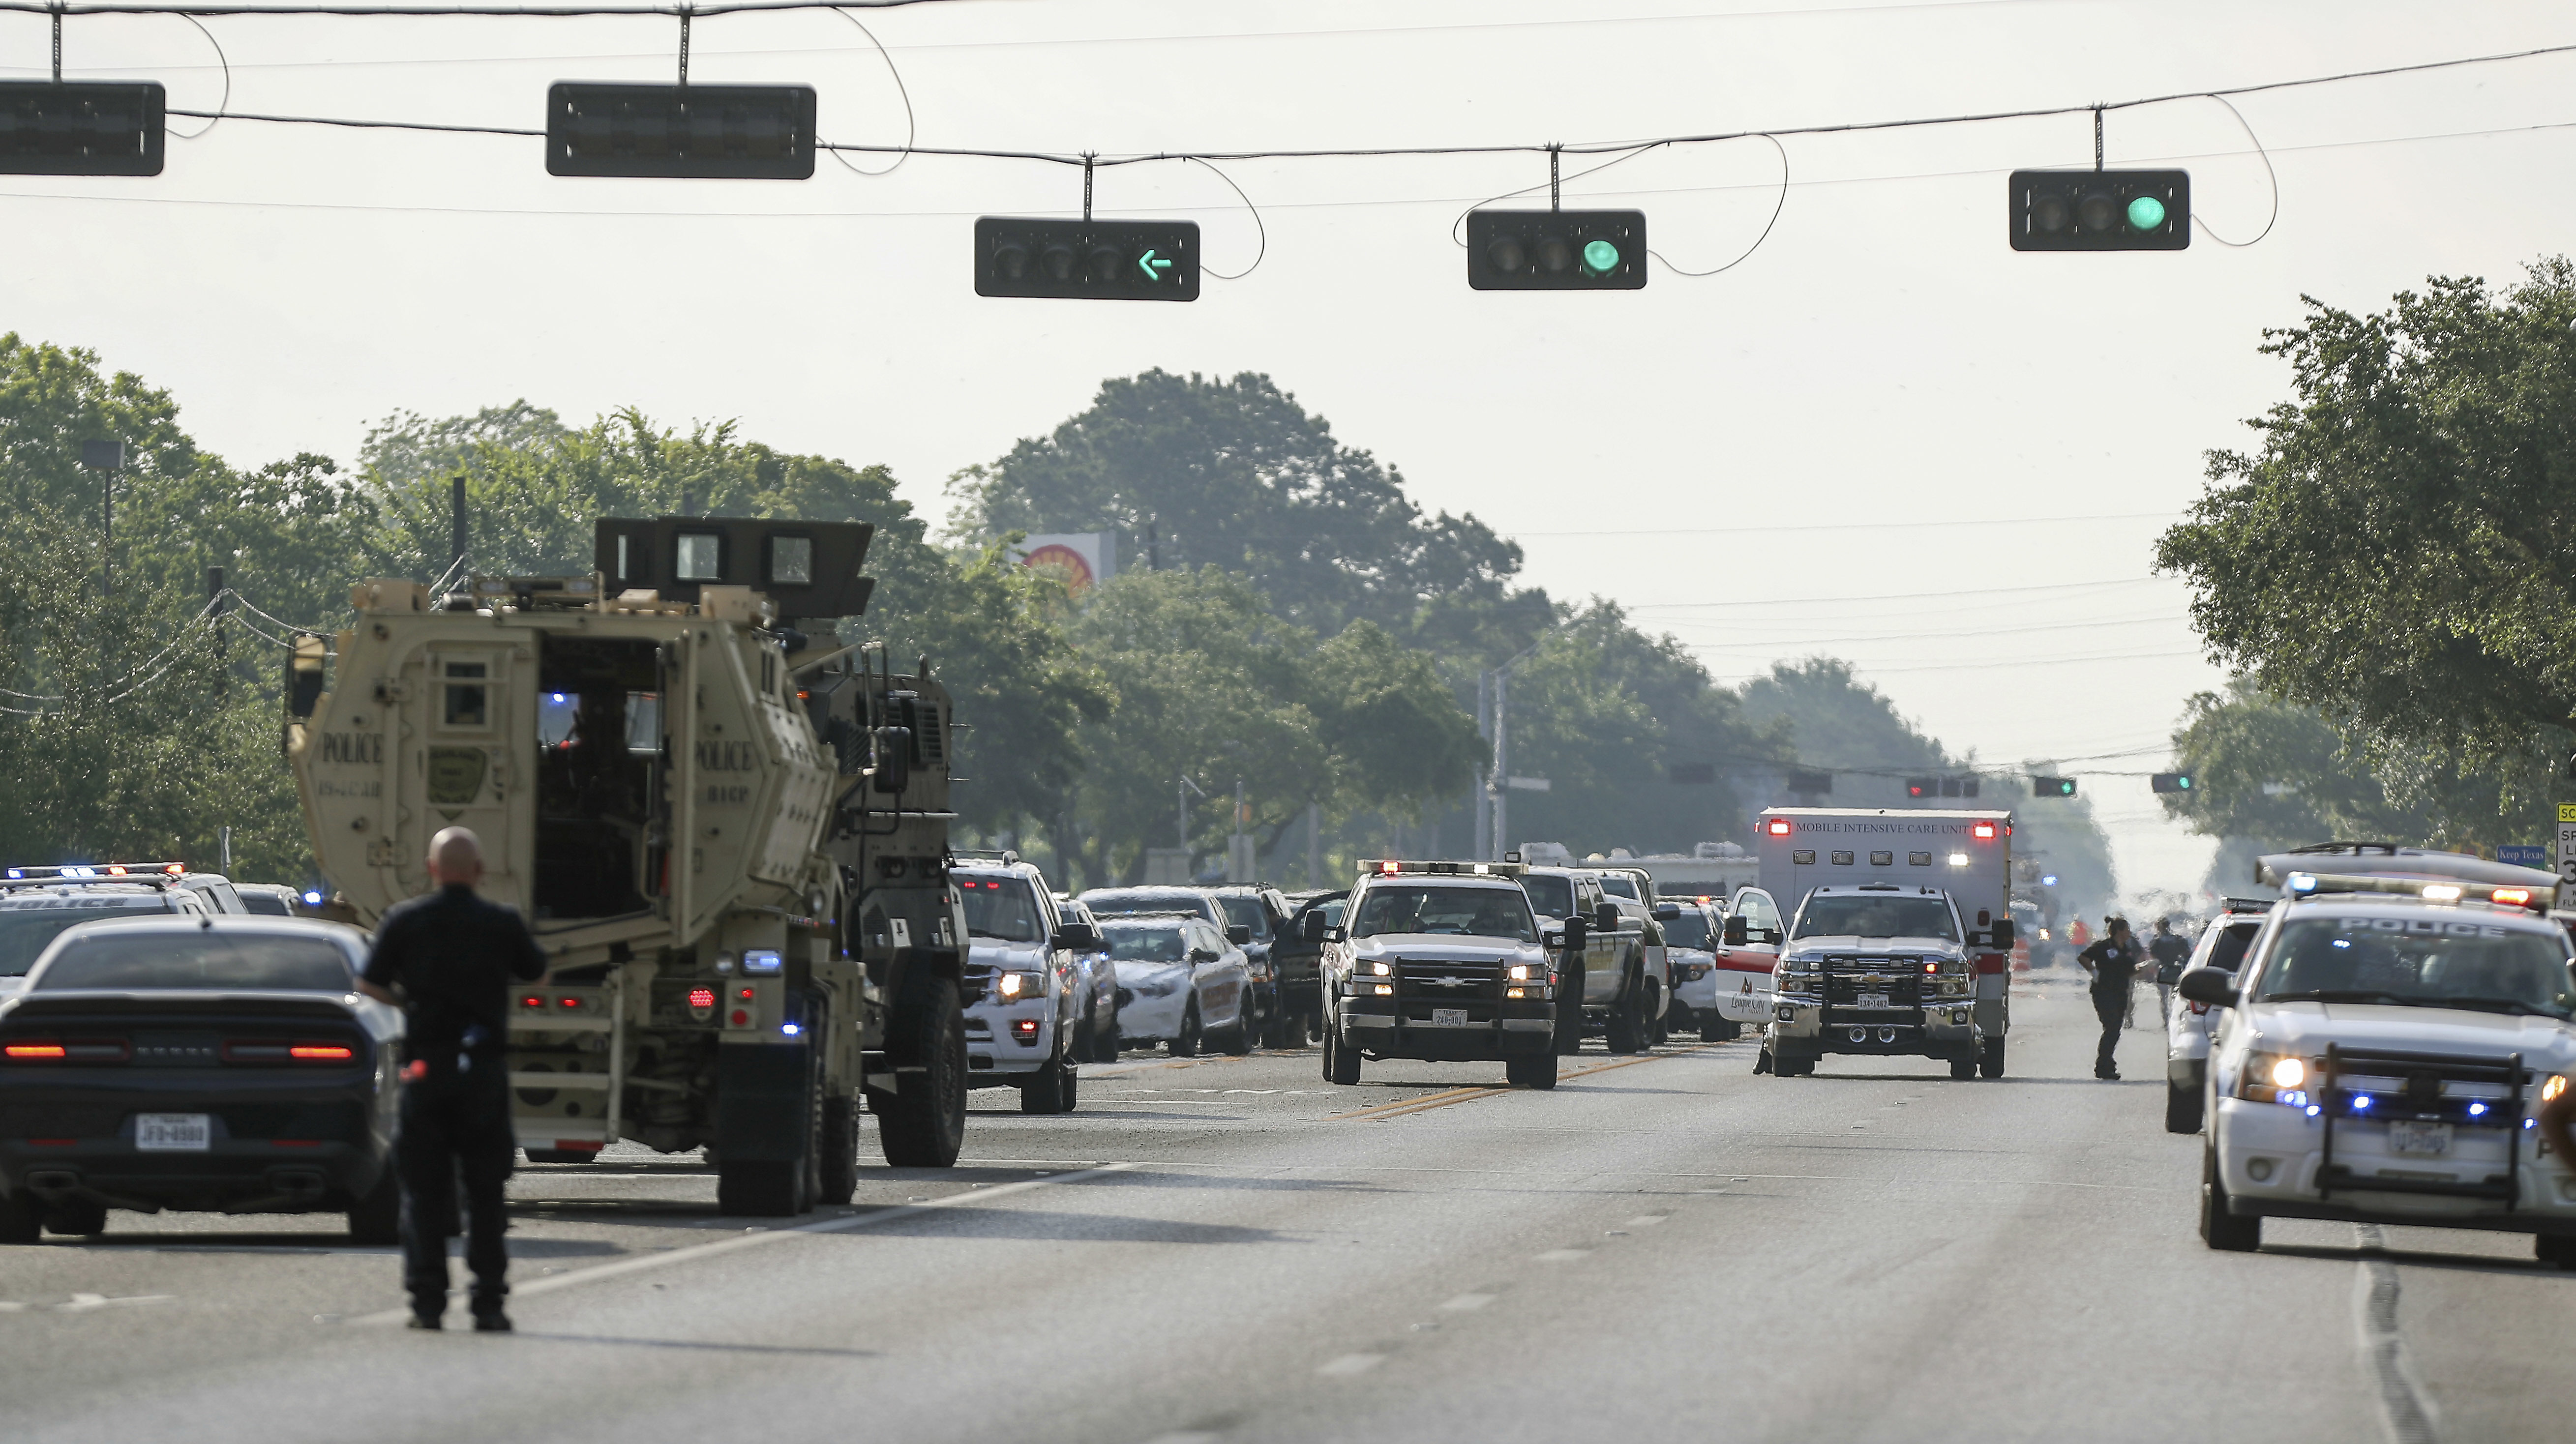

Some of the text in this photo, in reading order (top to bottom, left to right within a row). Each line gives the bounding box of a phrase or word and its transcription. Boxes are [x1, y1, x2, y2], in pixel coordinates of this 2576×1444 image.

[322, 732, 384, 763] POLICE
[1796, 822, 1969, 834] MOBILE INTENSIVE CARE UNIT
[2500, 849, 2544, 861] Keep Texas
[2339, 917, 2506, 938] POLICE
[1731, 993, 1765, 1014] League City
